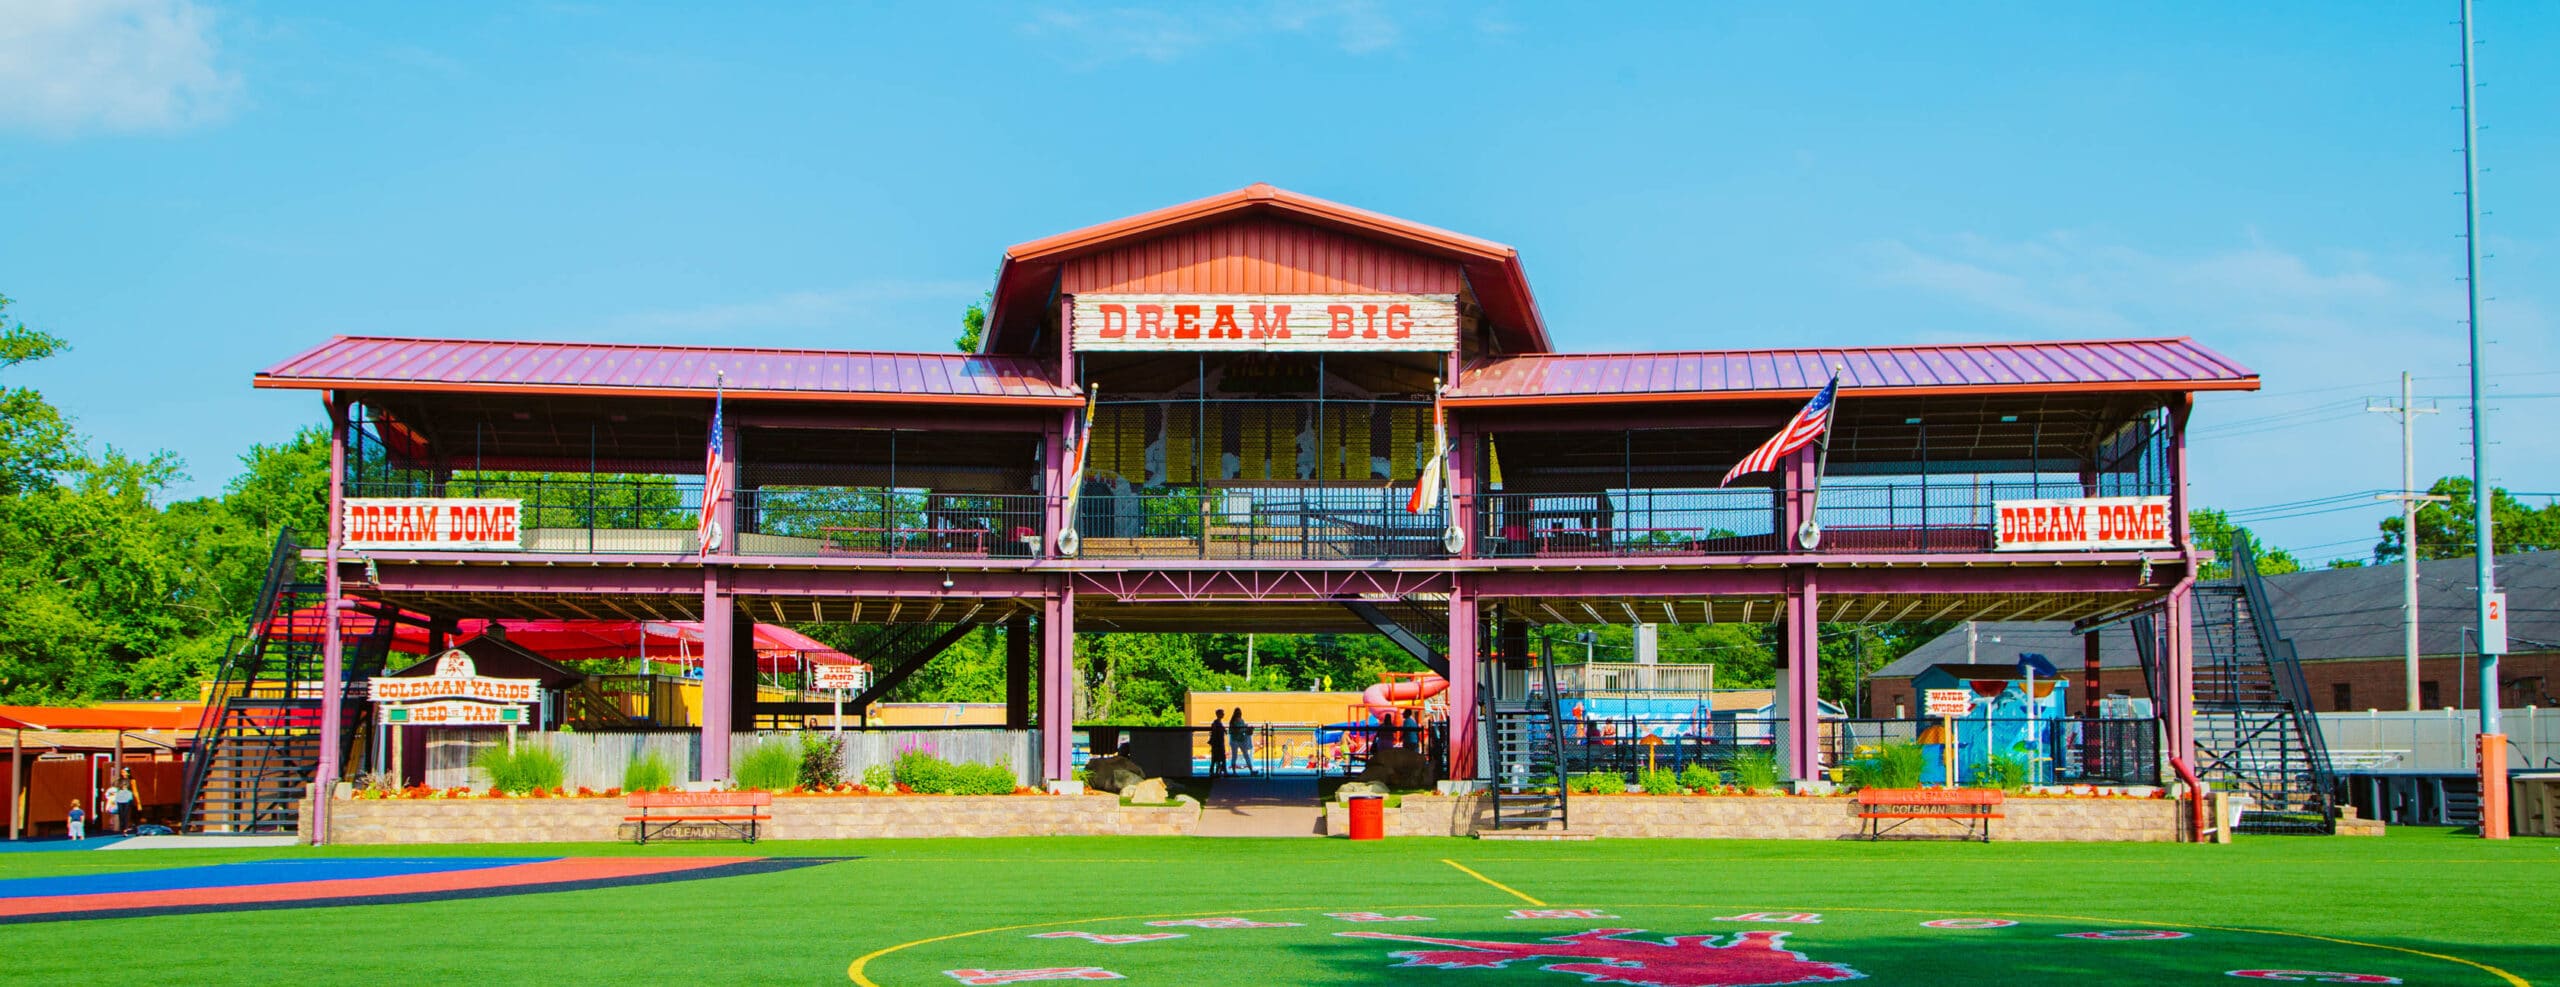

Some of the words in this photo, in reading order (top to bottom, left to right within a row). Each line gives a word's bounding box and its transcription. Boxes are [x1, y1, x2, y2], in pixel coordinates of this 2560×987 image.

[1099, 304, 1292, 340] DREAM
[1327, 303, 1415, 340] BIG
[351, 505, 439, 542] DREAM
[449, 505, 515, 542] DOME
[2001, 505, 2088, 543] DREAM
[2098, 504, 2165, 541] DOME
[2488, 601, 2499, 620] 2
[378, 680, 467, 699] COLEMAN
[470, 680, 530, 699] YARDS
[828, 681, 850, 689] LOT
[1931, 691, 1964, 701] WATER
[414, 705, 448, 722] RED
[462, 705, 497, 722] TAN
[1891, 804, 1947, 814] COLEMAN
[662, 827, 717, 838] COLEMAN
